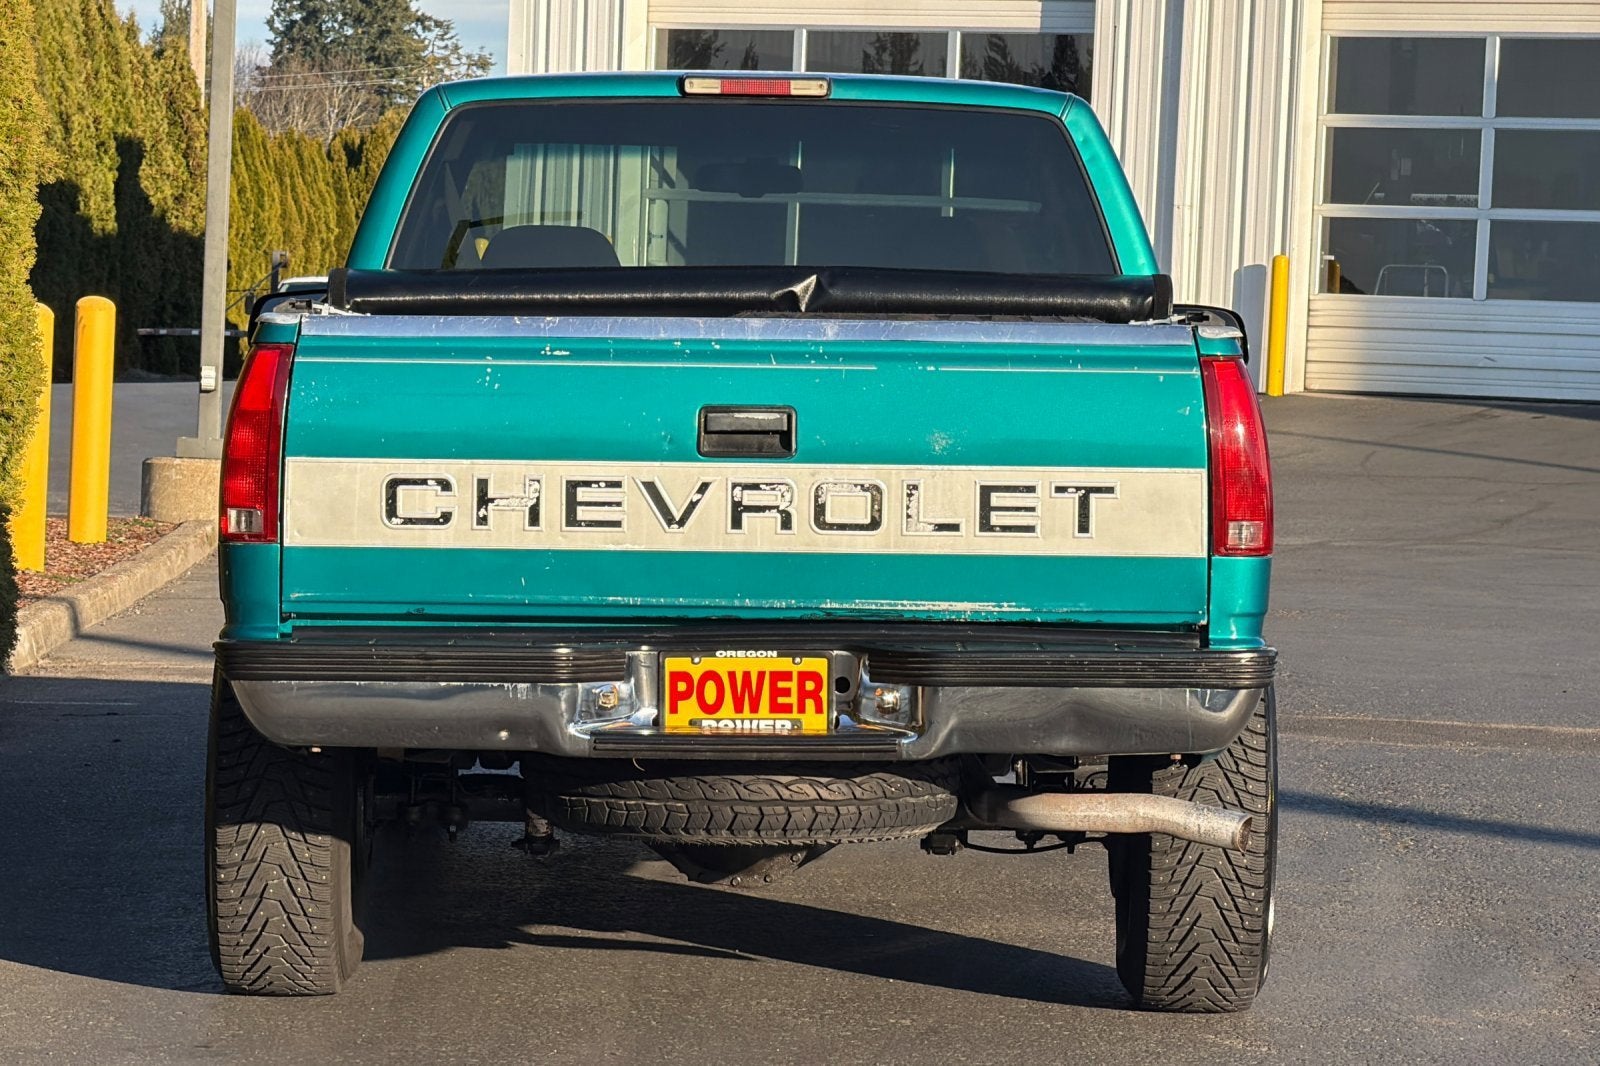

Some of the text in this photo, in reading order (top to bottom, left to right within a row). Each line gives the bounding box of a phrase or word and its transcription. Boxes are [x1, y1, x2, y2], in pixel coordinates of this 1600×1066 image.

[382, 473, 1119, 538] CHEVROLET
[715, 650, 778, 658] OREGON
[668, 670, 824, 715] POWER
